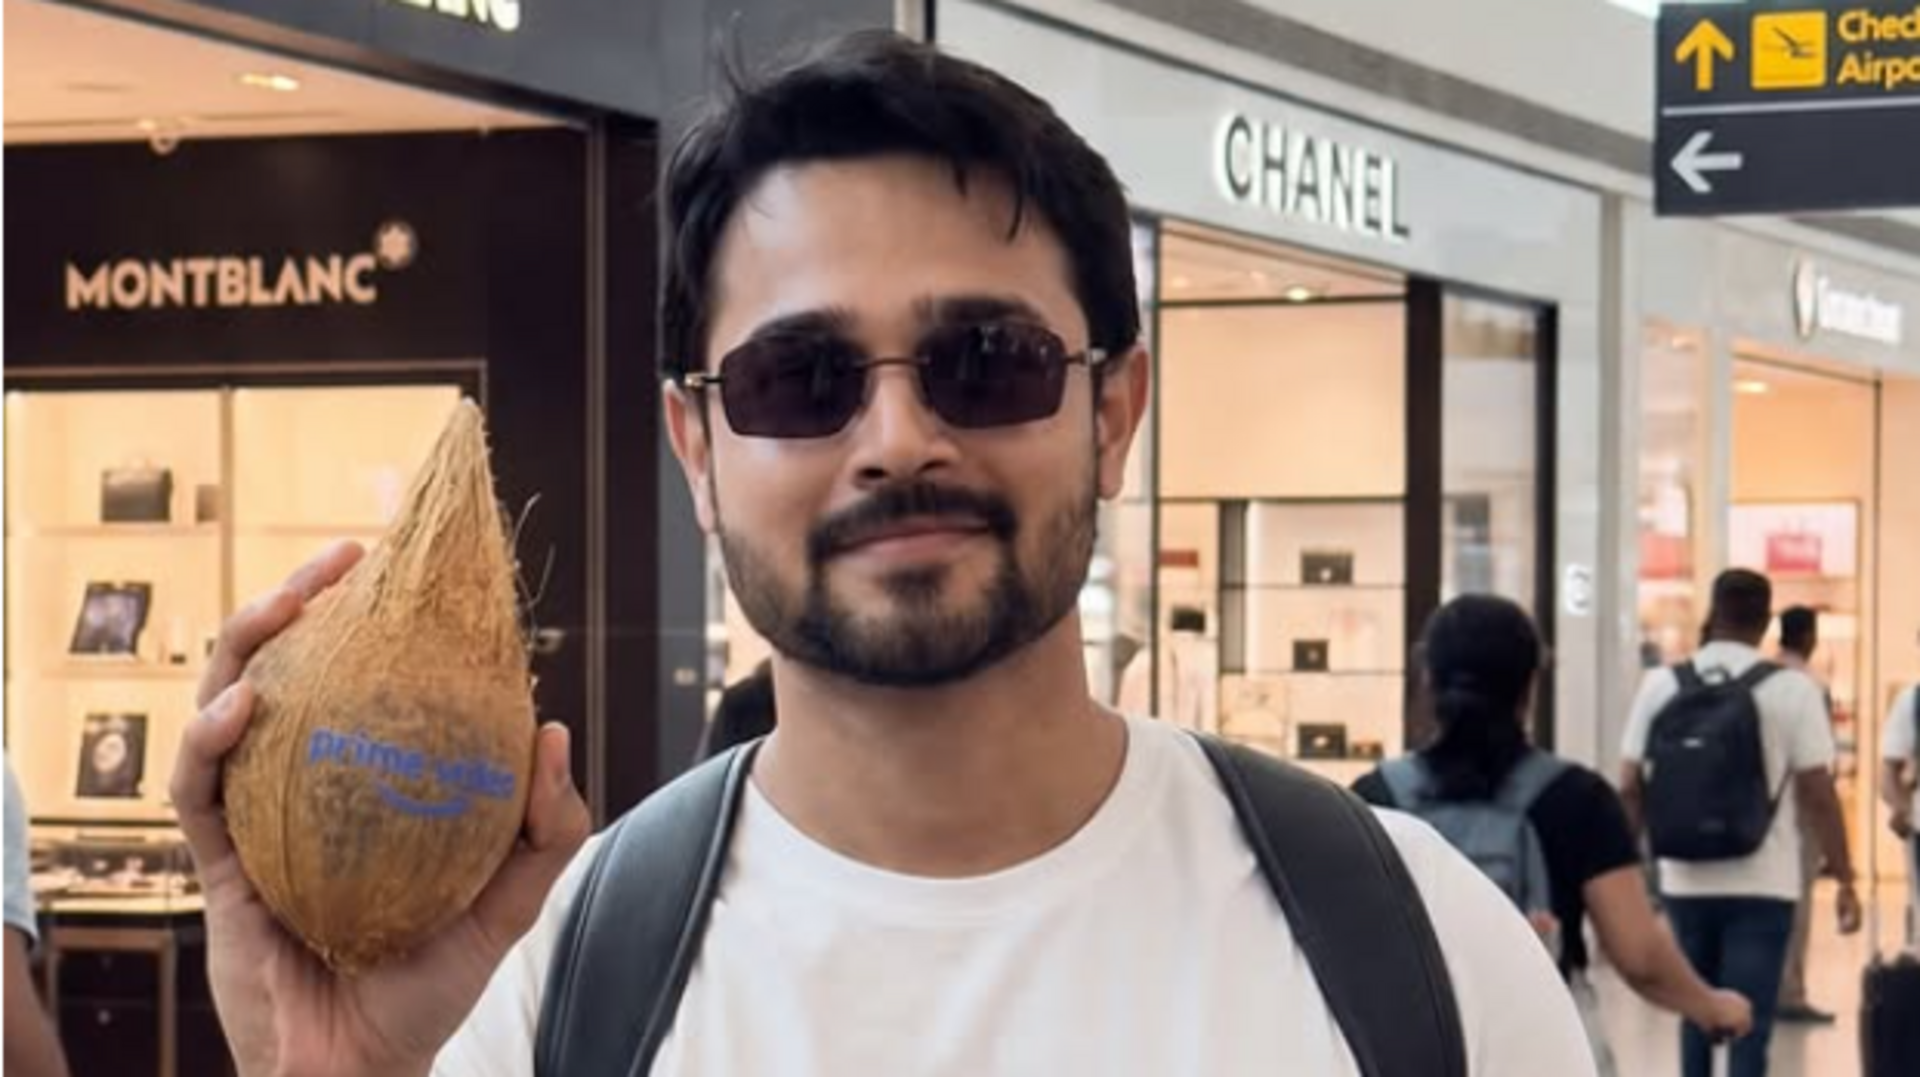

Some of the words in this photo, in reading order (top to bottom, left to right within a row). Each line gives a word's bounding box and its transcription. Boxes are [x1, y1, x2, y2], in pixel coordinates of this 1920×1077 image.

[1838, 5, 1920, 41] Chec
[1220, 112, 1410, 239] CHANEL
[66, 253, 377, 310] MONTBLANC
[308, 727, 424, 779] prime
